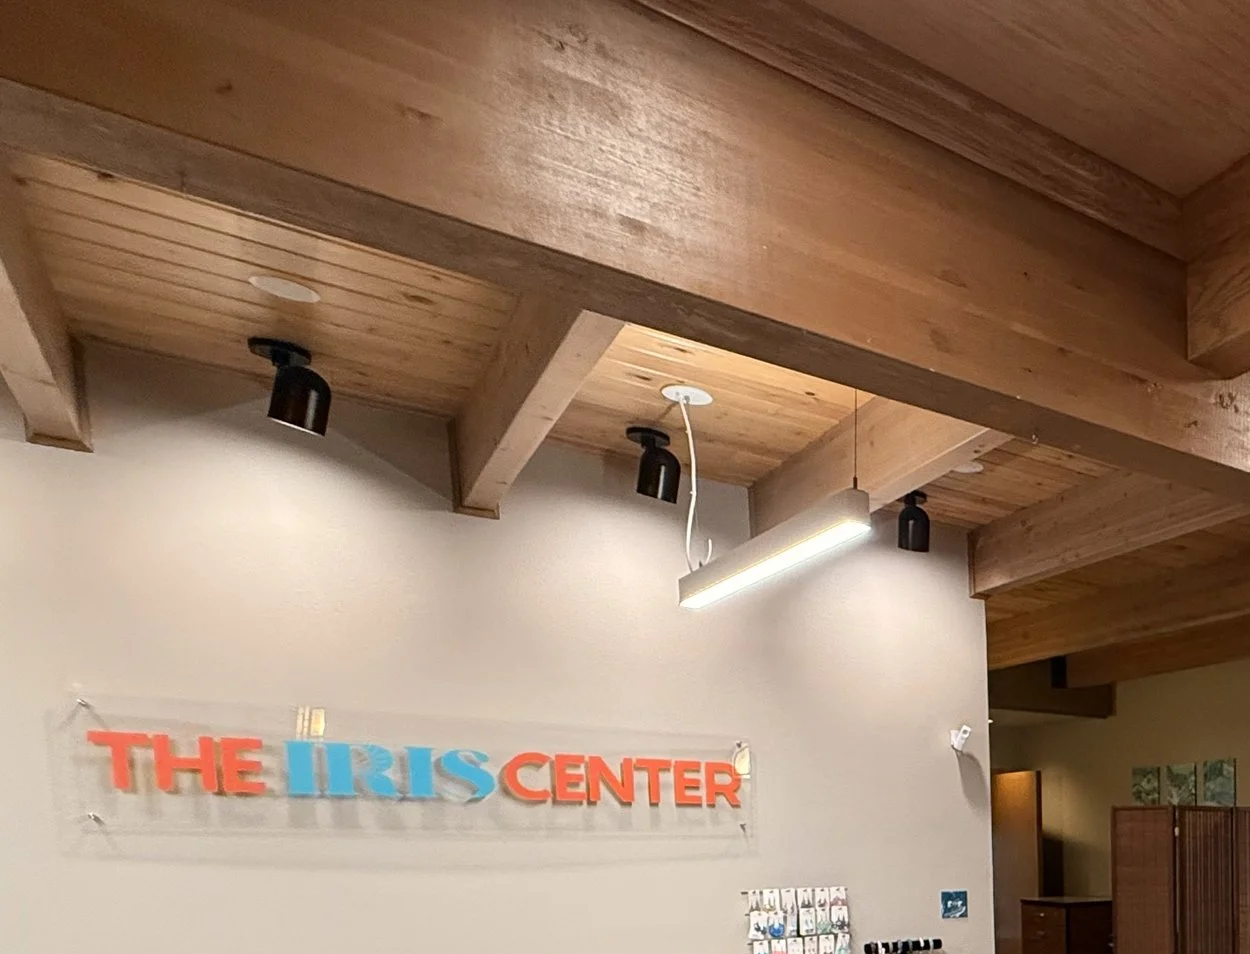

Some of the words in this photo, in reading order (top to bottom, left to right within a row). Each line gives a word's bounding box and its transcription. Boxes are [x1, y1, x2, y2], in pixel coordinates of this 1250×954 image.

[86, 730, 265, 794] THE
[283, 739, 496, 801] IRIS
[502, 752, 741, 806] CENTER
